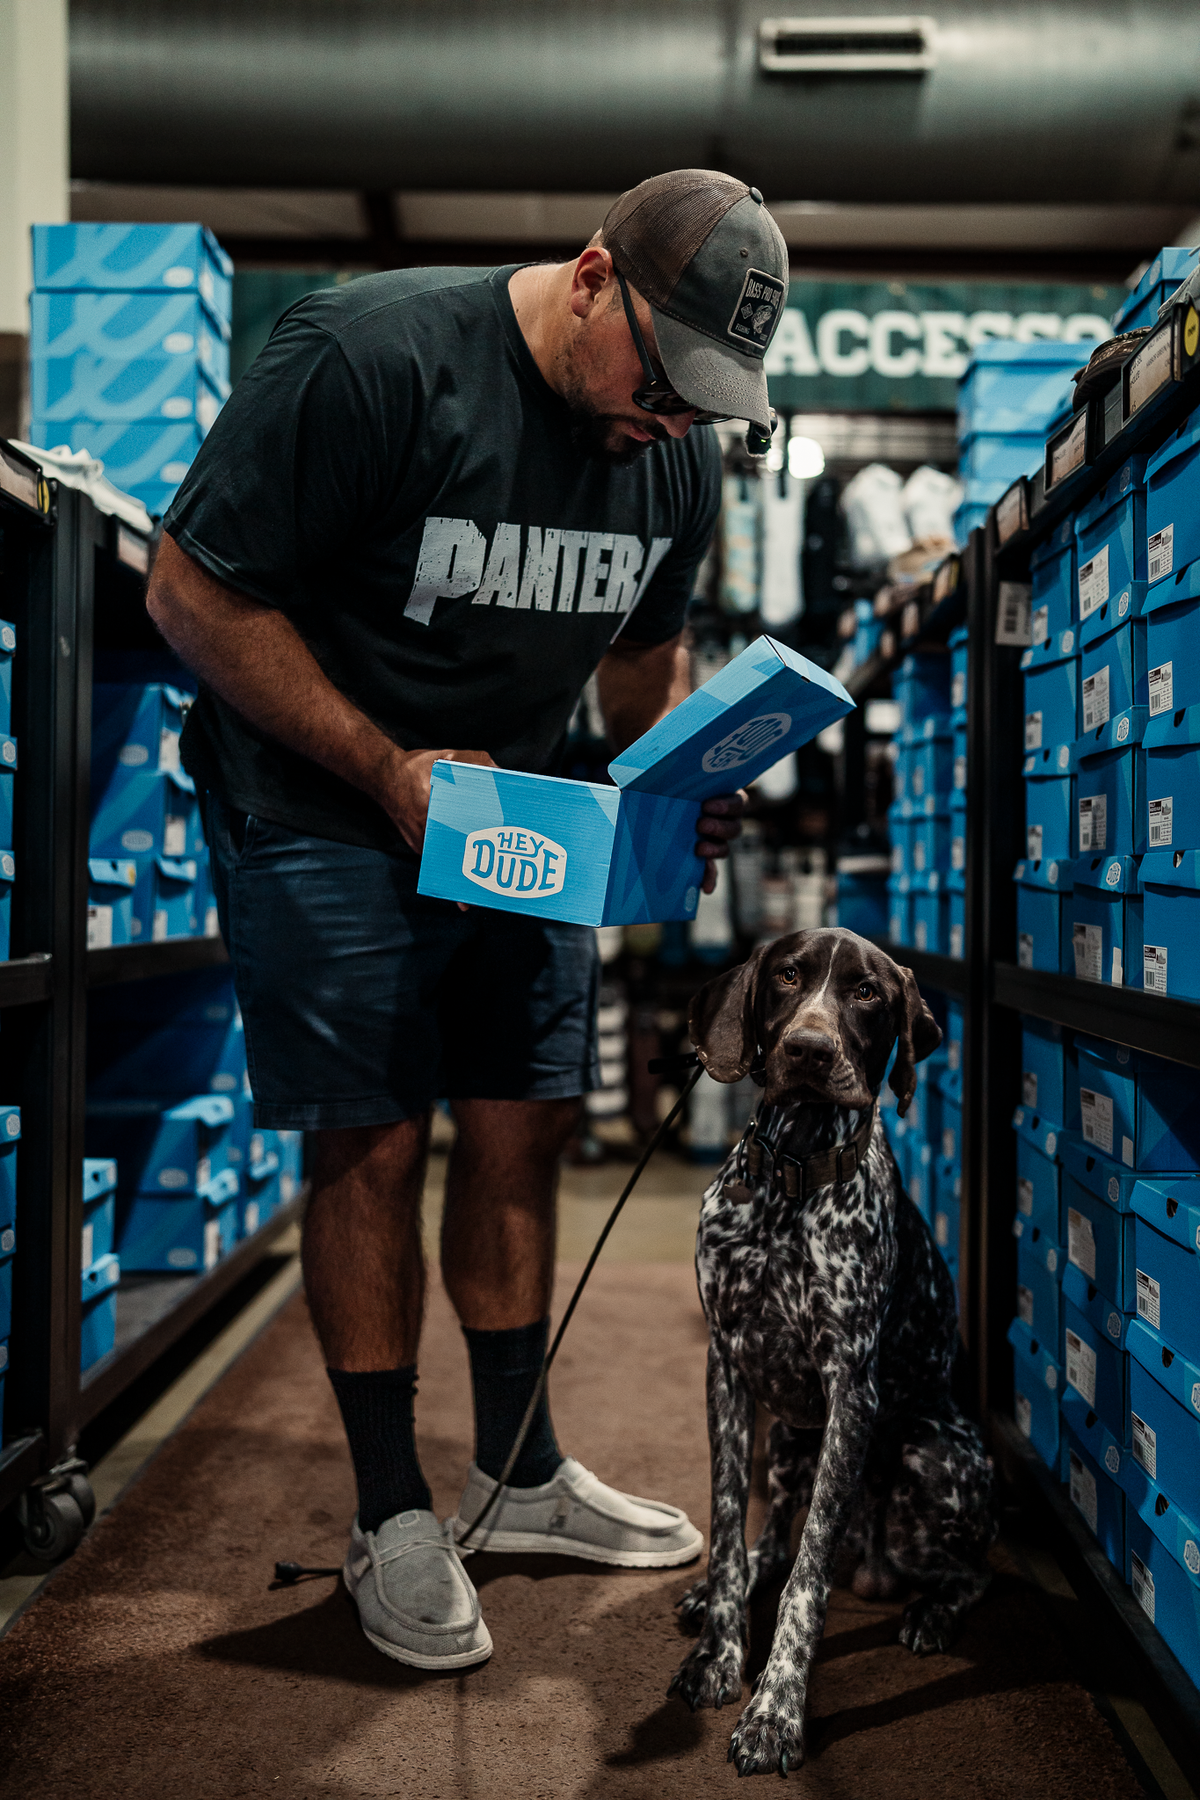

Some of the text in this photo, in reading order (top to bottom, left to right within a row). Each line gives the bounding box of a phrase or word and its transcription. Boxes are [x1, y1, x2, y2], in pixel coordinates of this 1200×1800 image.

[745, 279, 763, 299] BASS
[497, 832, 544, 858] HEY
[470, 839, 559, 892] DUDE
